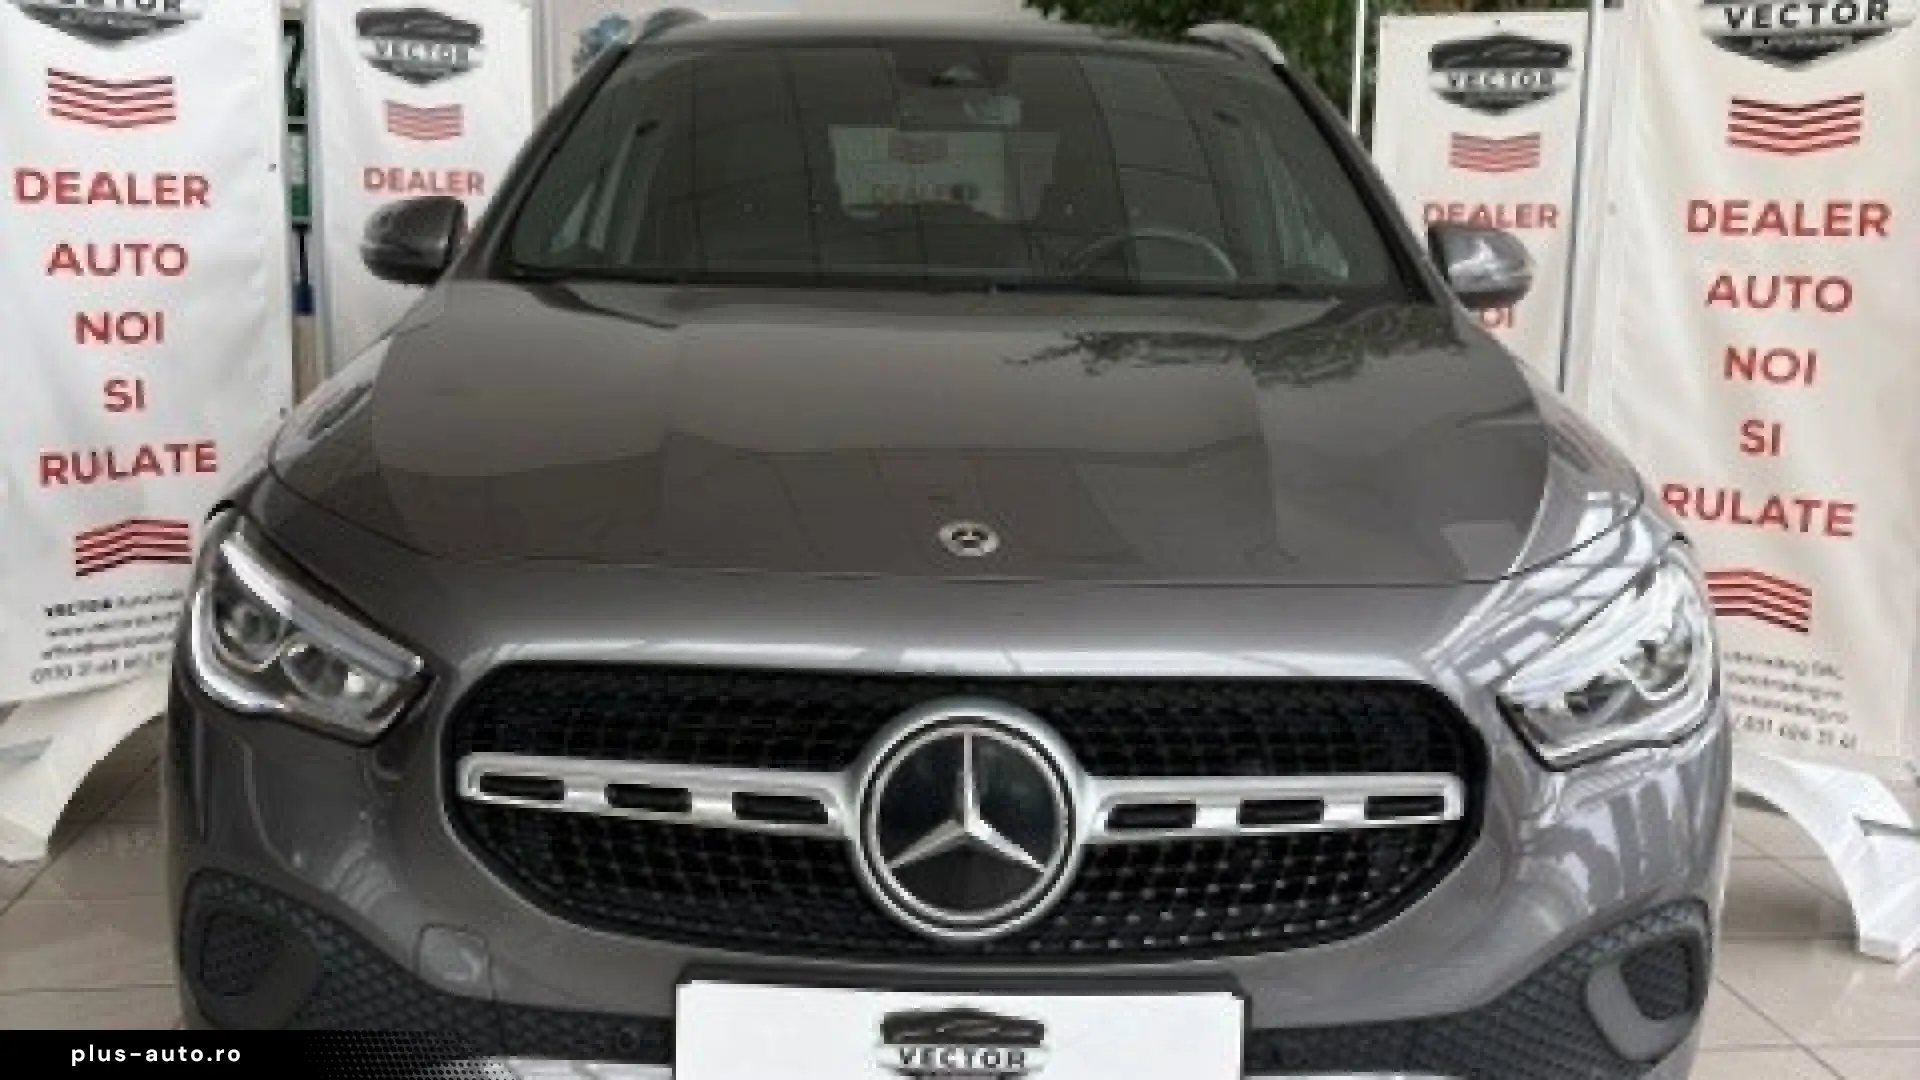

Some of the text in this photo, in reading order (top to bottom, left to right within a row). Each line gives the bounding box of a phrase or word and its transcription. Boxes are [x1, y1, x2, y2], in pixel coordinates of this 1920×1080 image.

[1724, 0, 1889, 29] VECTOR
[1447, 69, 1556, 89] VECTOR
[14, 169, 210, 207] DEALER
[363, 167, 485, 195] DEALER
[1423, 203, 1558, 229] DEALER
[1687, 200, 1892, 237] DEALER
[47, 243, 190, 276] AUTO
[1706, 274, 1853, 313] AUTO
[75, 311, 165, 344] NOI
[1723, 347, 1816, 386] NOI
[103, 378, 146, 413] SI
[1739, 418, 1782, 457] SI
[39, 440, 219, 485] RULATE
[1661, 482, 1856, 538] RULATE
[899, 1047, 1025, 1069] VECTOR
